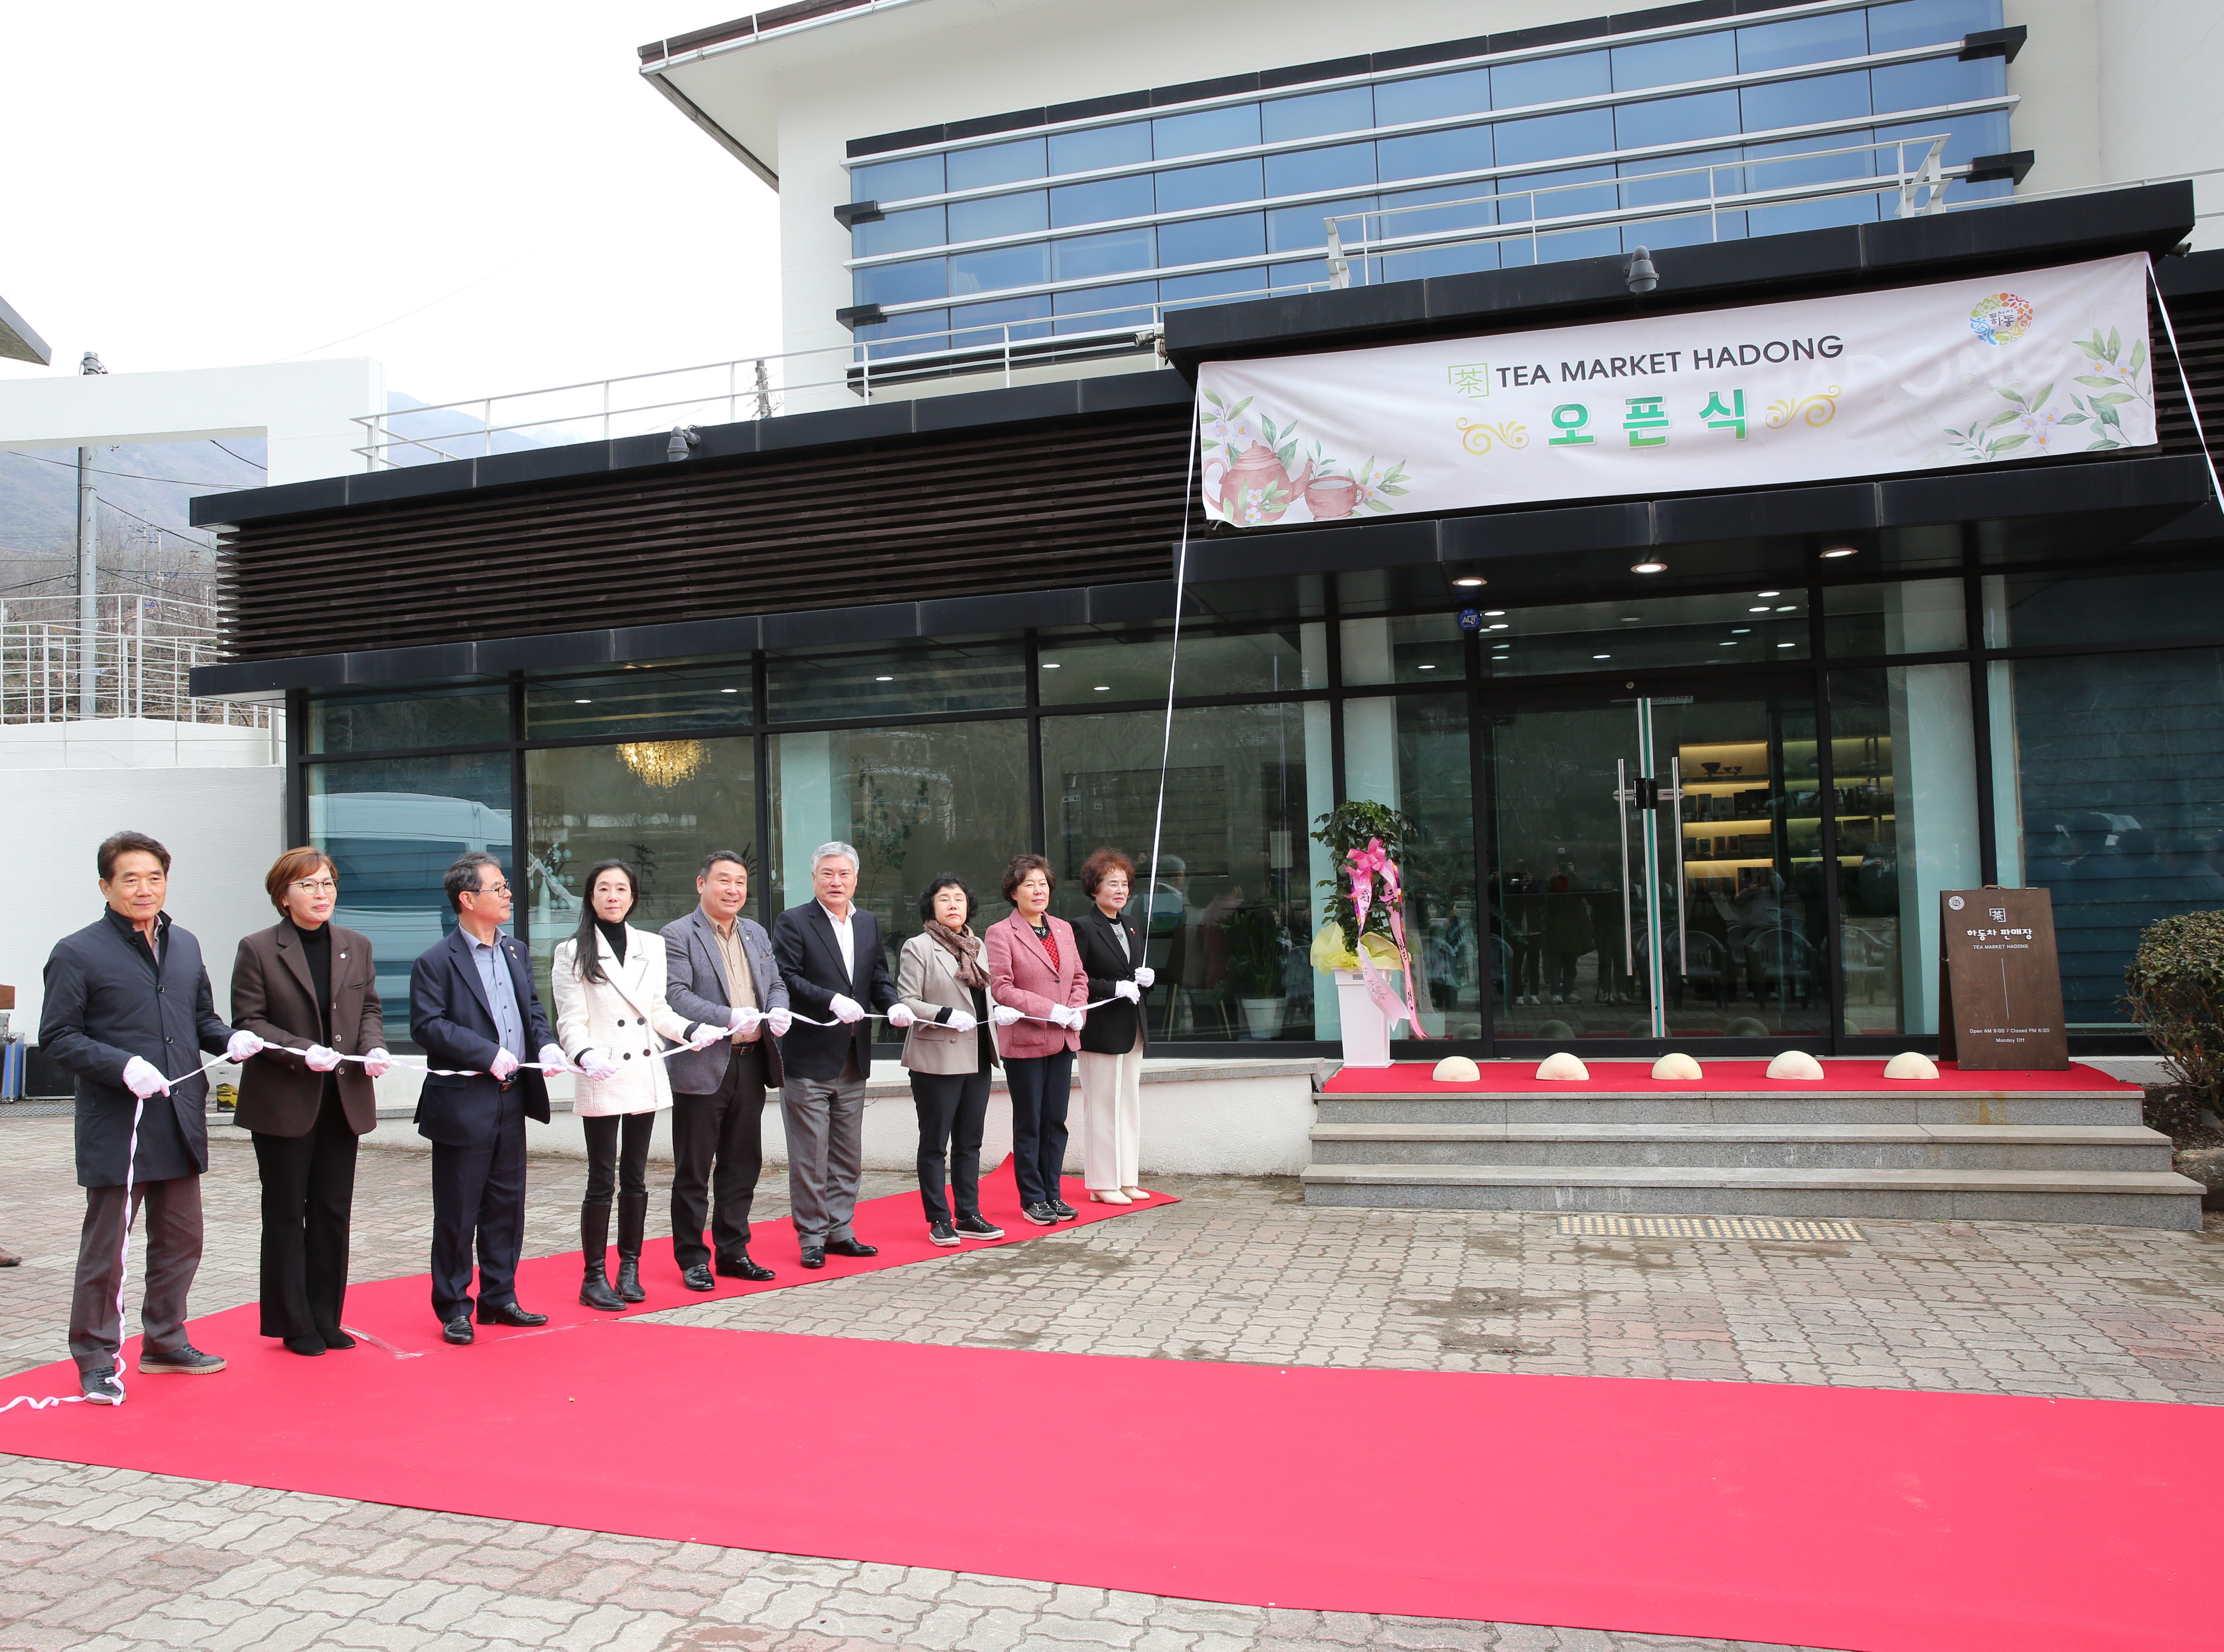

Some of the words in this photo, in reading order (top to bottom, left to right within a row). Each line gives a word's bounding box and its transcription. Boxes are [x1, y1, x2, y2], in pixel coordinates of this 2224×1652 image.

[1496, 364, 1551, 388] TEA
[1561, 351, 1681, 382] MARKET
[1693, 335, 1844, 370] HADONG
[1462, 615, 1477, 624] ADT
[1966, 929, 1997, 941] 하동차
[2000, 928, 2033, 940] 판매장
